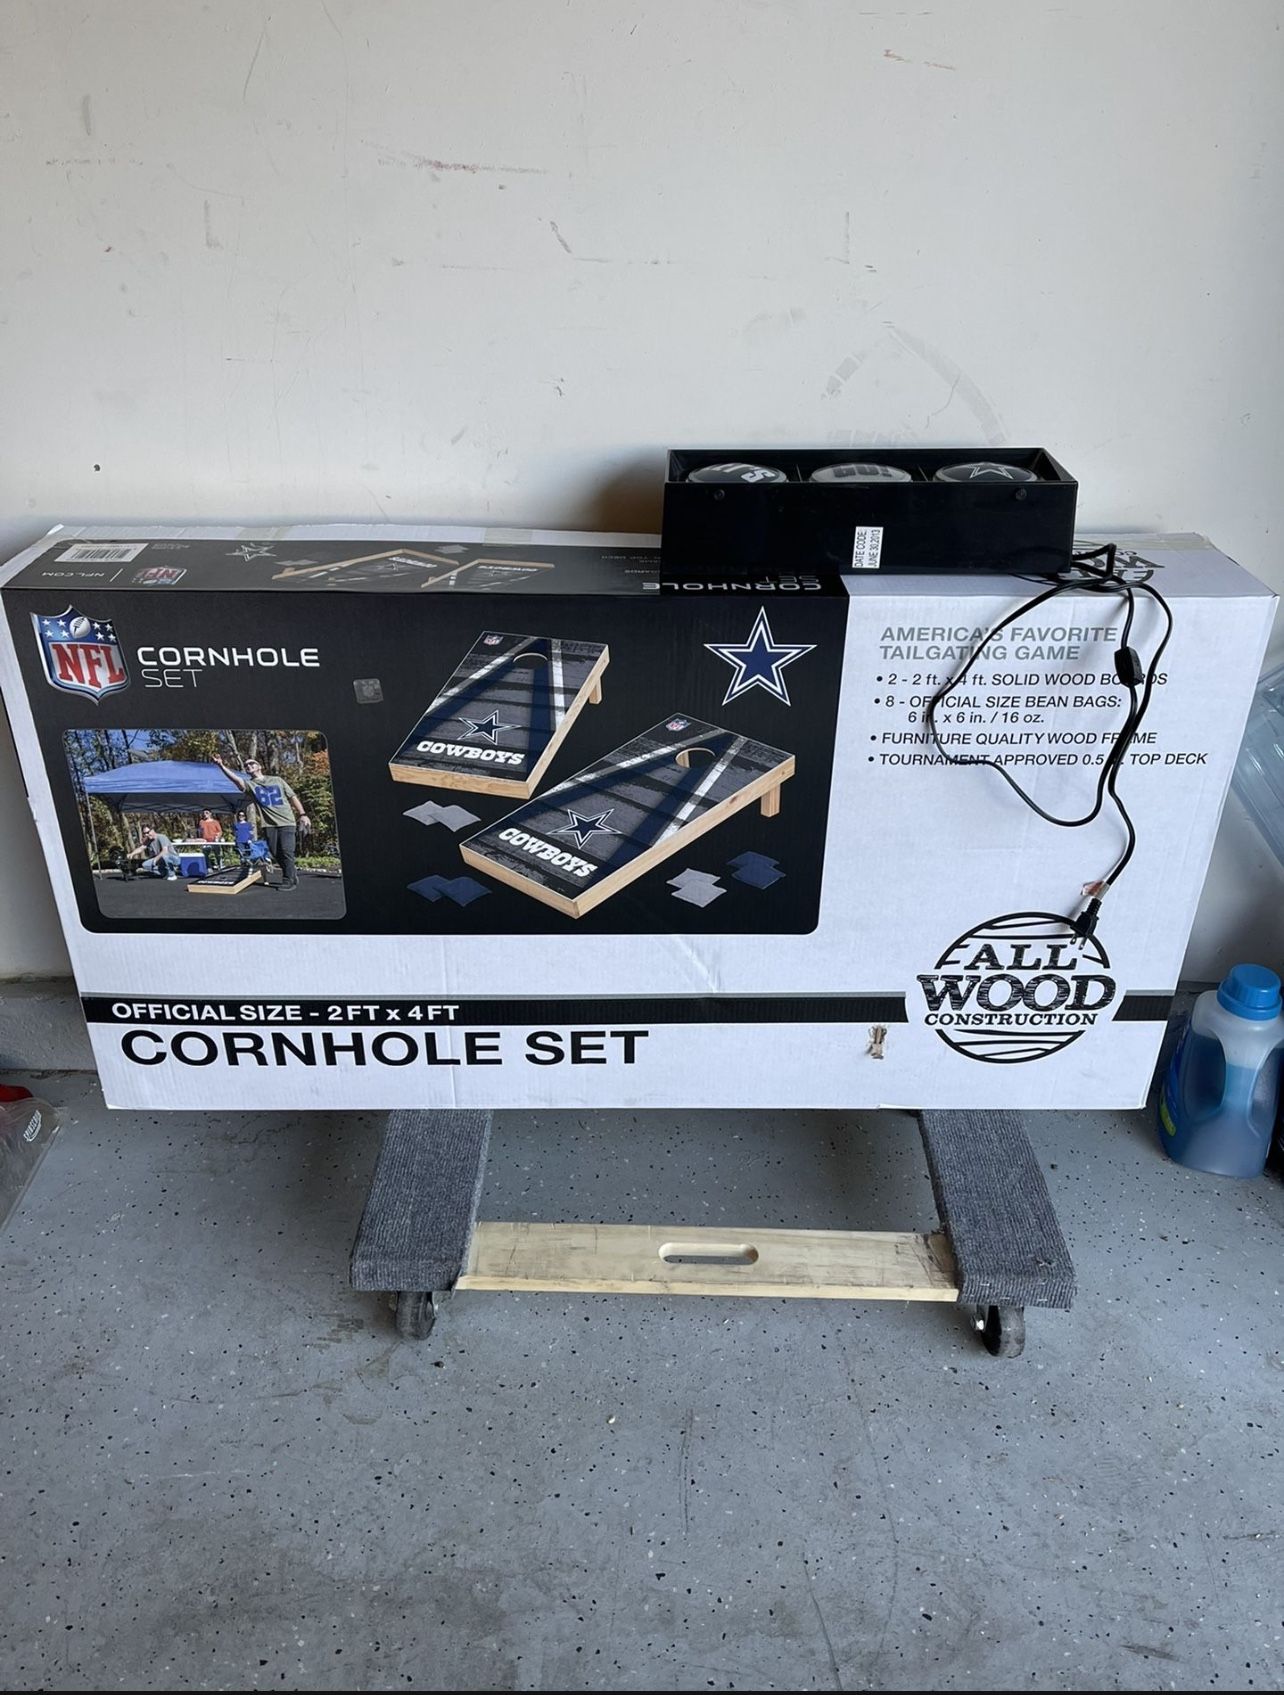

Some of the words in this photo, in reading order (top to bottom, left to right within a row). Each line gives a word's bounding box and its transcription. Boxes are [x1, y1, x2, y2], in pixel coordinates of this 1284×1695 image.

[854, 550, 865, 567] DATE
[868, 551, 879, 567] JUNE
[642, 582, 822, 591] CORNHOLE
[880, 627, 1005, 642] AMERICA'S
[1010, 627, 1118, 642] FAVORITE
[137, 647, 320, 668] CORNHOLE
[1015, 645, 1081, 660] GAME
[53, 643, 125, 688] NFL
[141, 668, 203, 688] SET
[887, 673, 897, 686] 2
[912, 673, 922, 686] 2
[926, 673, 943, 686] ft.
[946, 676, 955, 686] x
[972, 673, 988, 686] ft.
[992, 673, 1041, 686] SOLID
[1045, 673, 1097, 686] WOOD
[886, 695, 895, 708] 8
[909, 695, 981, 708] OFICIAL
[985, 695, 1021, 708] SIZE
[1025, 695, 1069, 708] BEAN
[1073, 695, 1122, 708] BAGS:
[908, 711, 917, 723] 6
[942, 714, 952, 723] x
[955, 711, 965, 723] 6
[969, 711, 987, 723] in.
[989, 711, 999, 723] /
[1002, 711, 1020, 723] 16
[1023, 714, 1045, 723] oz.
[882, 732, 971, 745] FURNITURE
[976, 732, 1046, 746] QUALITY
[1048, 732, 1097, 745] WOOD
[1101, 732, 1158, 745] FRME
[416, 739, 526, 766] COWBOYS
[879, 752, 992, 766] TOURNAMENT
[993, 752, 1078, 766] APPROVED
[1082, 752, 1104, 766] 0.5
[1129, 752, 1162, 766] TOP
[1165, 752, 1208, 766] DECK
[498, 826, 600, 878] COWBOYS
[963, 943, 1078, 971] ALL
[916, 973, 1117, 1012] WOOD
[112, 1002, 235, 1021] OFFICIAL
[240, 1003, 302, 1021] SIZE
[386, 1007, 399, 1021] x
[925, 1012, 1099, 1026] CONSTRUCTION
[121, 1028, 503, 1068] CORNHOLE
[524, 1028, 649, 1066] SET
